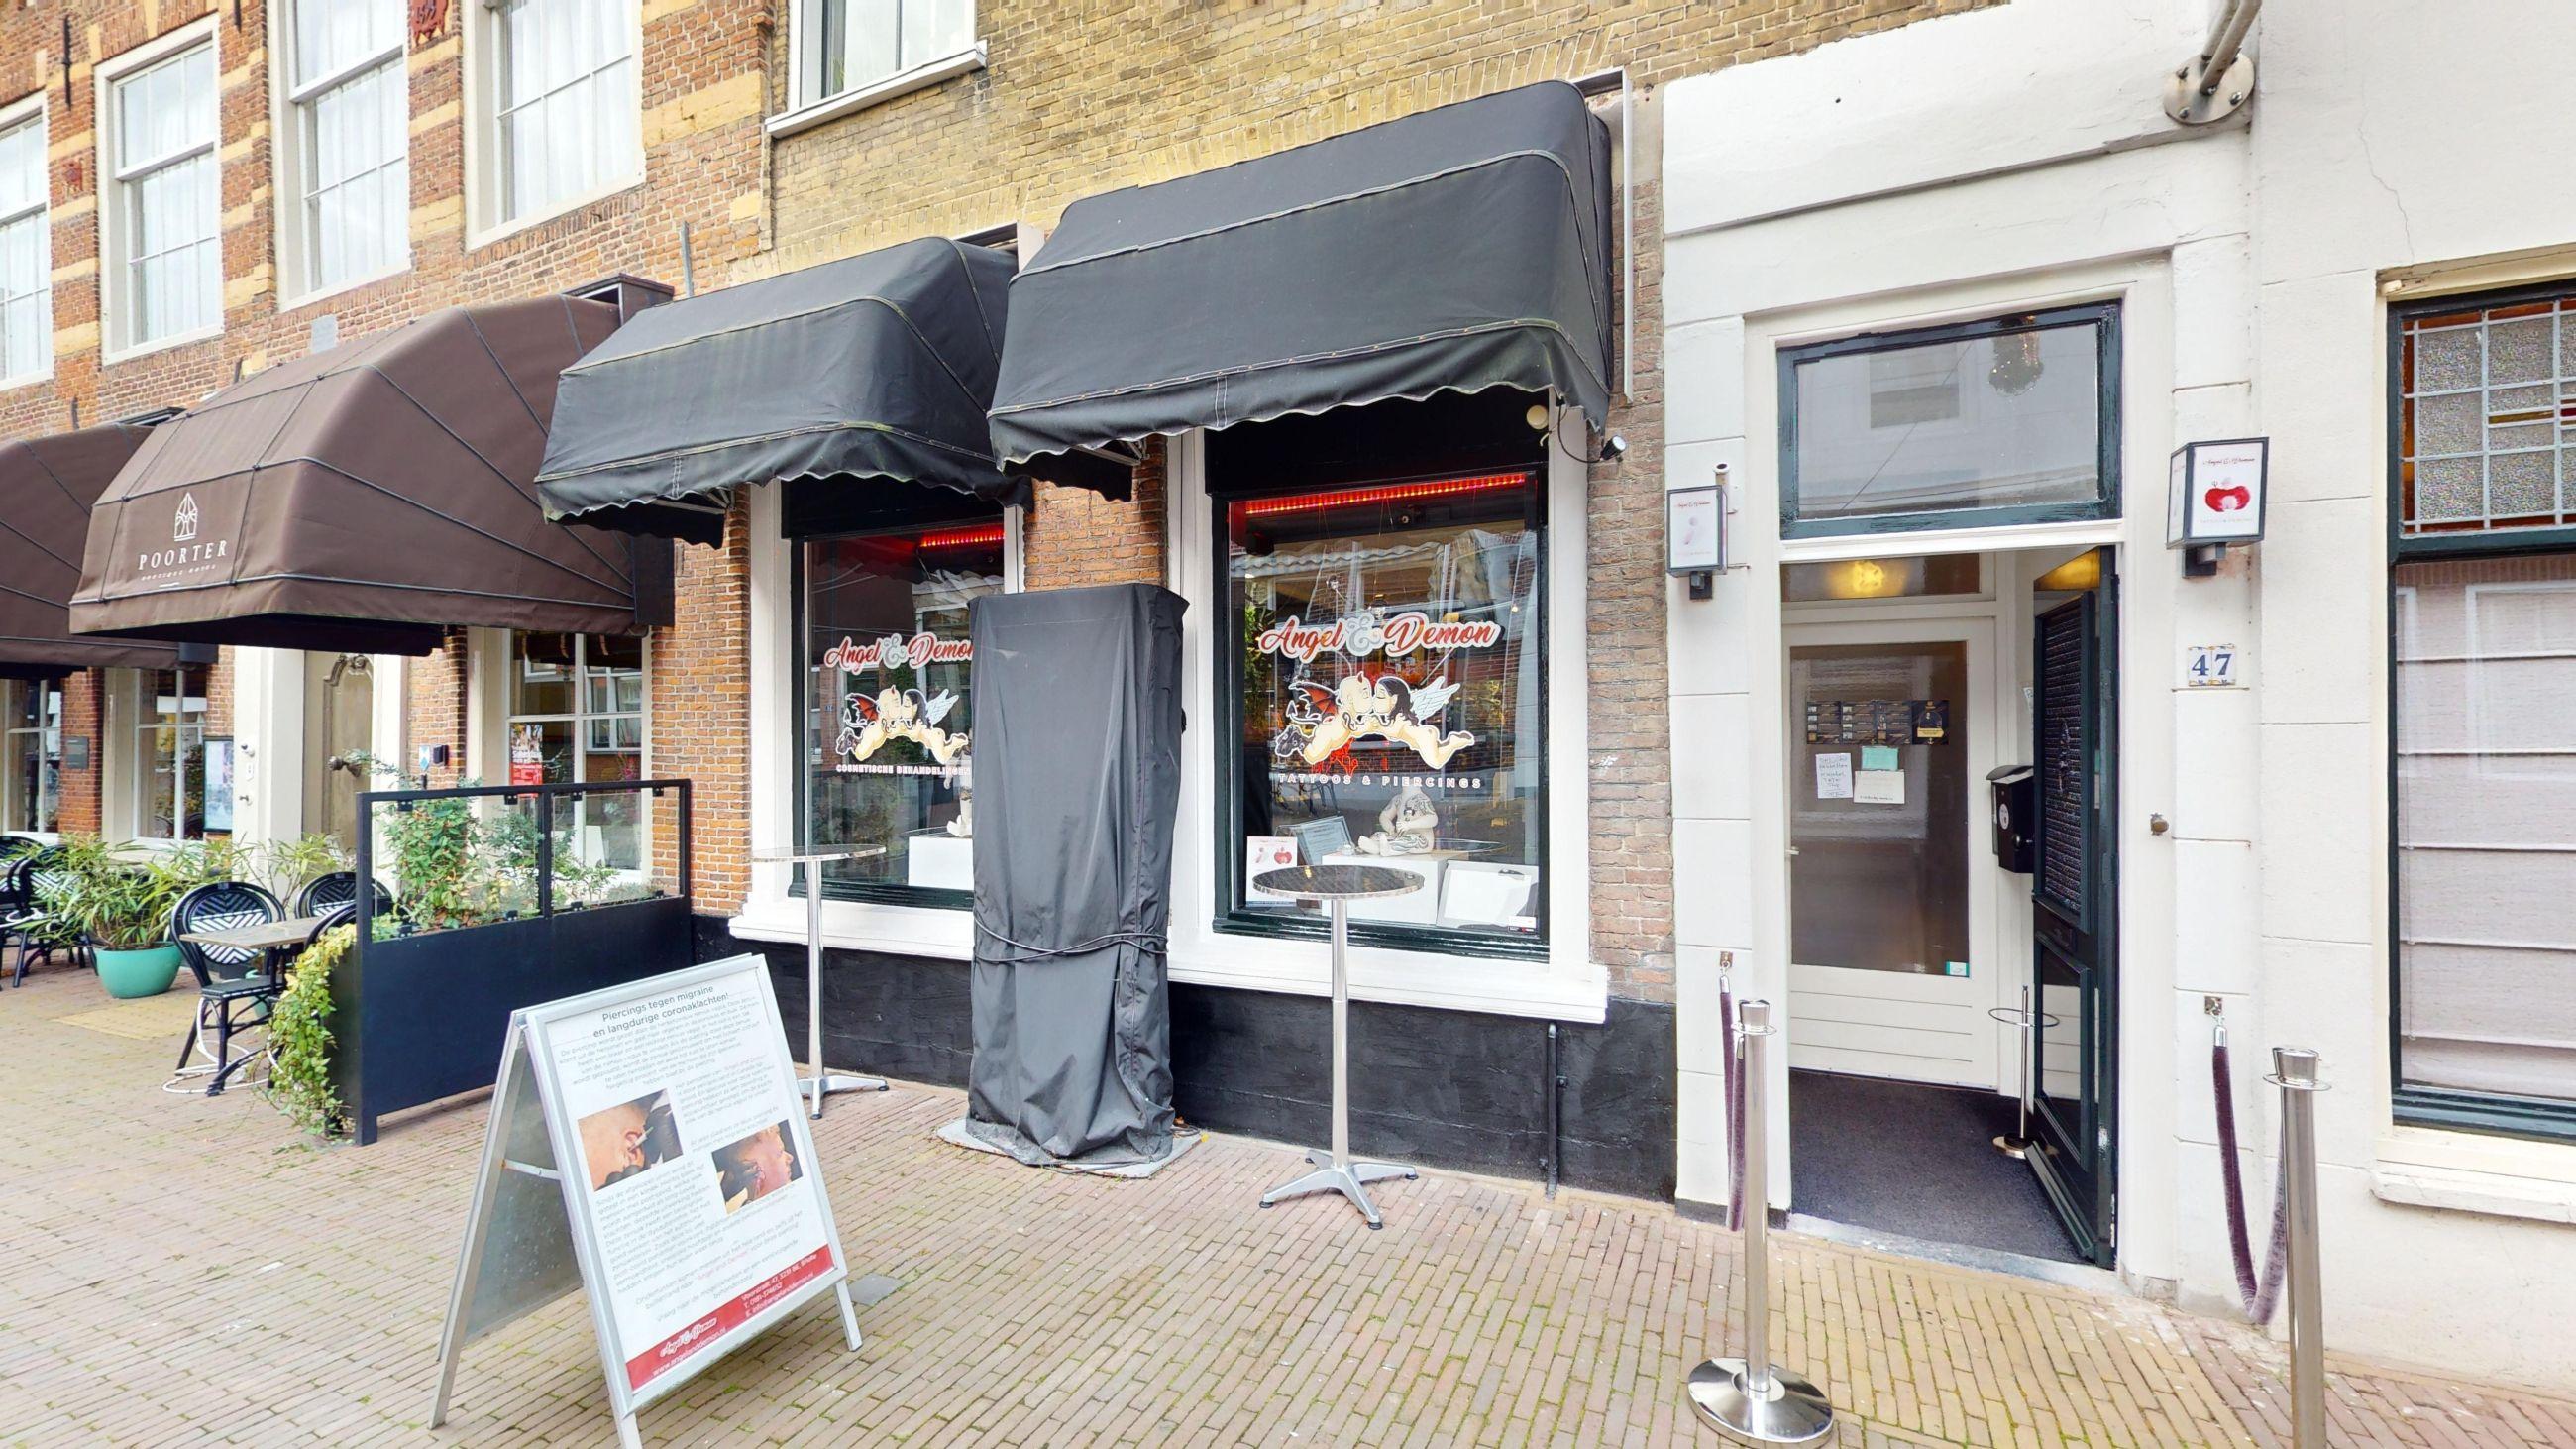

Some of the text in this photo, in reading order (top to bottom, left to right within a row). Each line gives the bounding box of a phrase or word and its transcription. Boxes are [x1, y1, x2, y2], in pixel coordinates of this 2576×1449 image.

[138, 540, 228, 571] POORTER
[824, 636, 884, 675] Angel
[883, 633, 909, 670] &
[1258, 612, 1503, 664] Angel & Demon
[2192, 653, 2232, 676] 47
[1278, 773, 1482, 789] TATTOOS & PIERCINGS
[592, 1026, 605, 1039] en
[606, 1011, 660, 1035] langdurige
[660, 992, 729, 1020] coronaklachten!
[601, 1002, 647, 1023] Piercings
[647, 995, 676, 1011] tegen
[676, 984, 714, 1003] migraine
